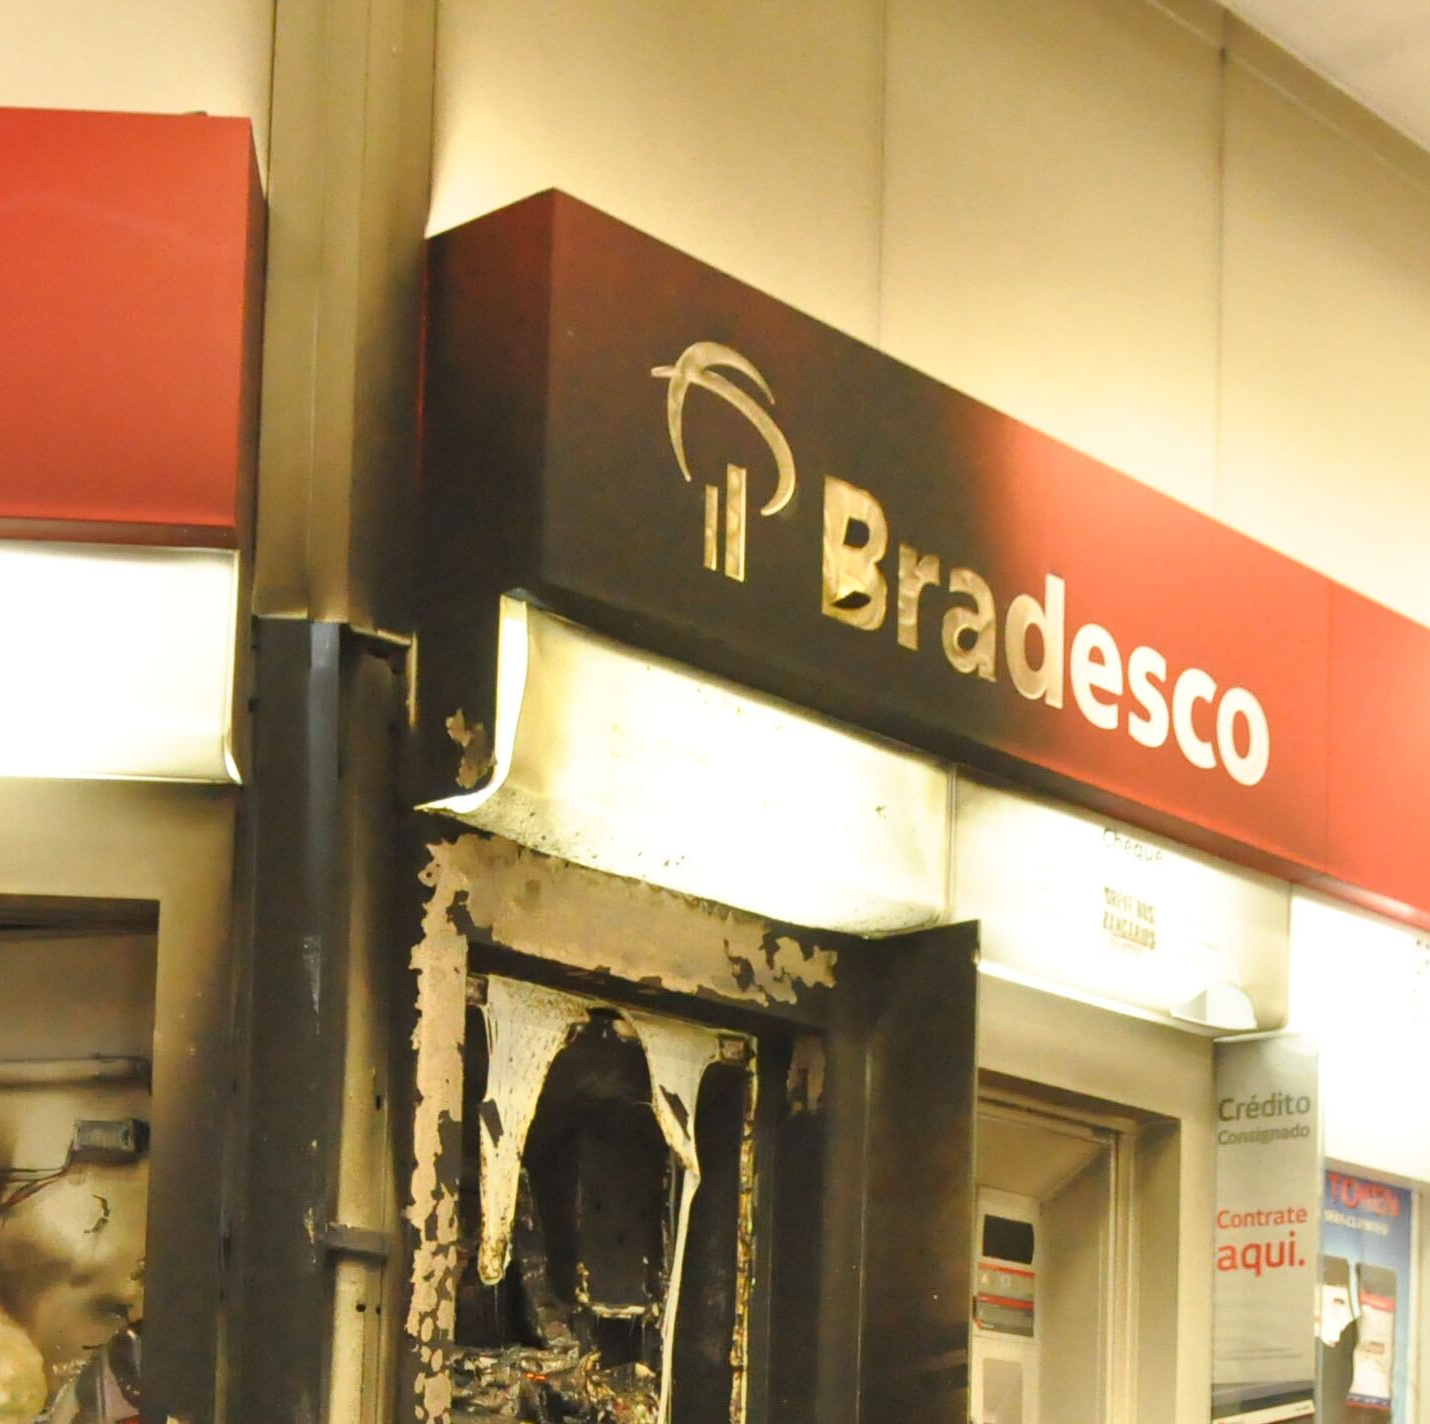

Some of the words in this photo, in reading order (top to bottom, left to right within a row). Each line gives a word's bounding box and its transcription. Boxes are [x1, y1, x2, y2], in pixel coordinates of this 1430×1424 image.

[822, 474, 1270, 786] Bradesco
[1218, 1091, 1311, 1122] Crédito
[1217, 1123, 1311, 1145] Consignado
[1216, 1207, 1308, 1230] Contrate
[1216, 1230, 1306, 1278] aqui.
